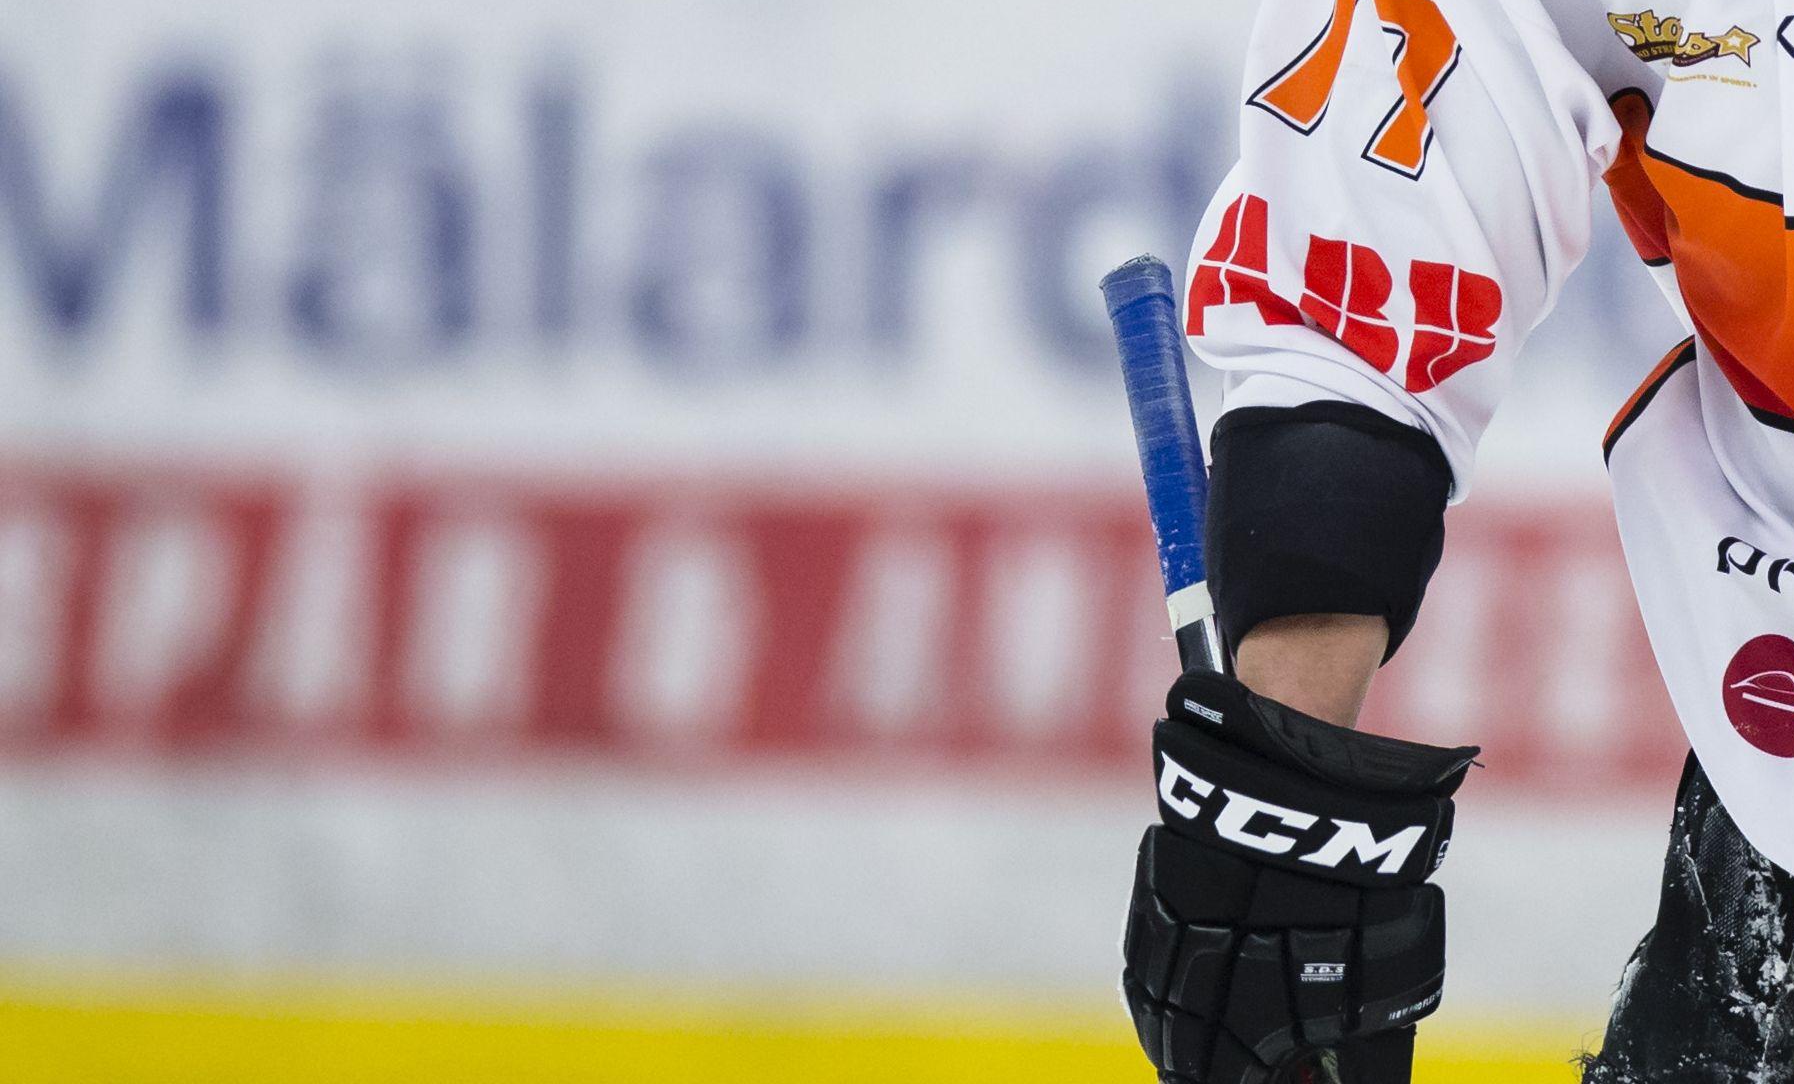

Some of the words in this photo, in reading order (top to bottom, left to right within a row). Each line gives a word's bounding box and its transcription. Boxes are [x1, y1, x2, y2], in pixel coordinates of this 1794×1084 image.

[0, 31, 1240, 396] Mälard
[1185, 192, 1503, 394] ABB
[1157, 750, 1428, 875] CCM
